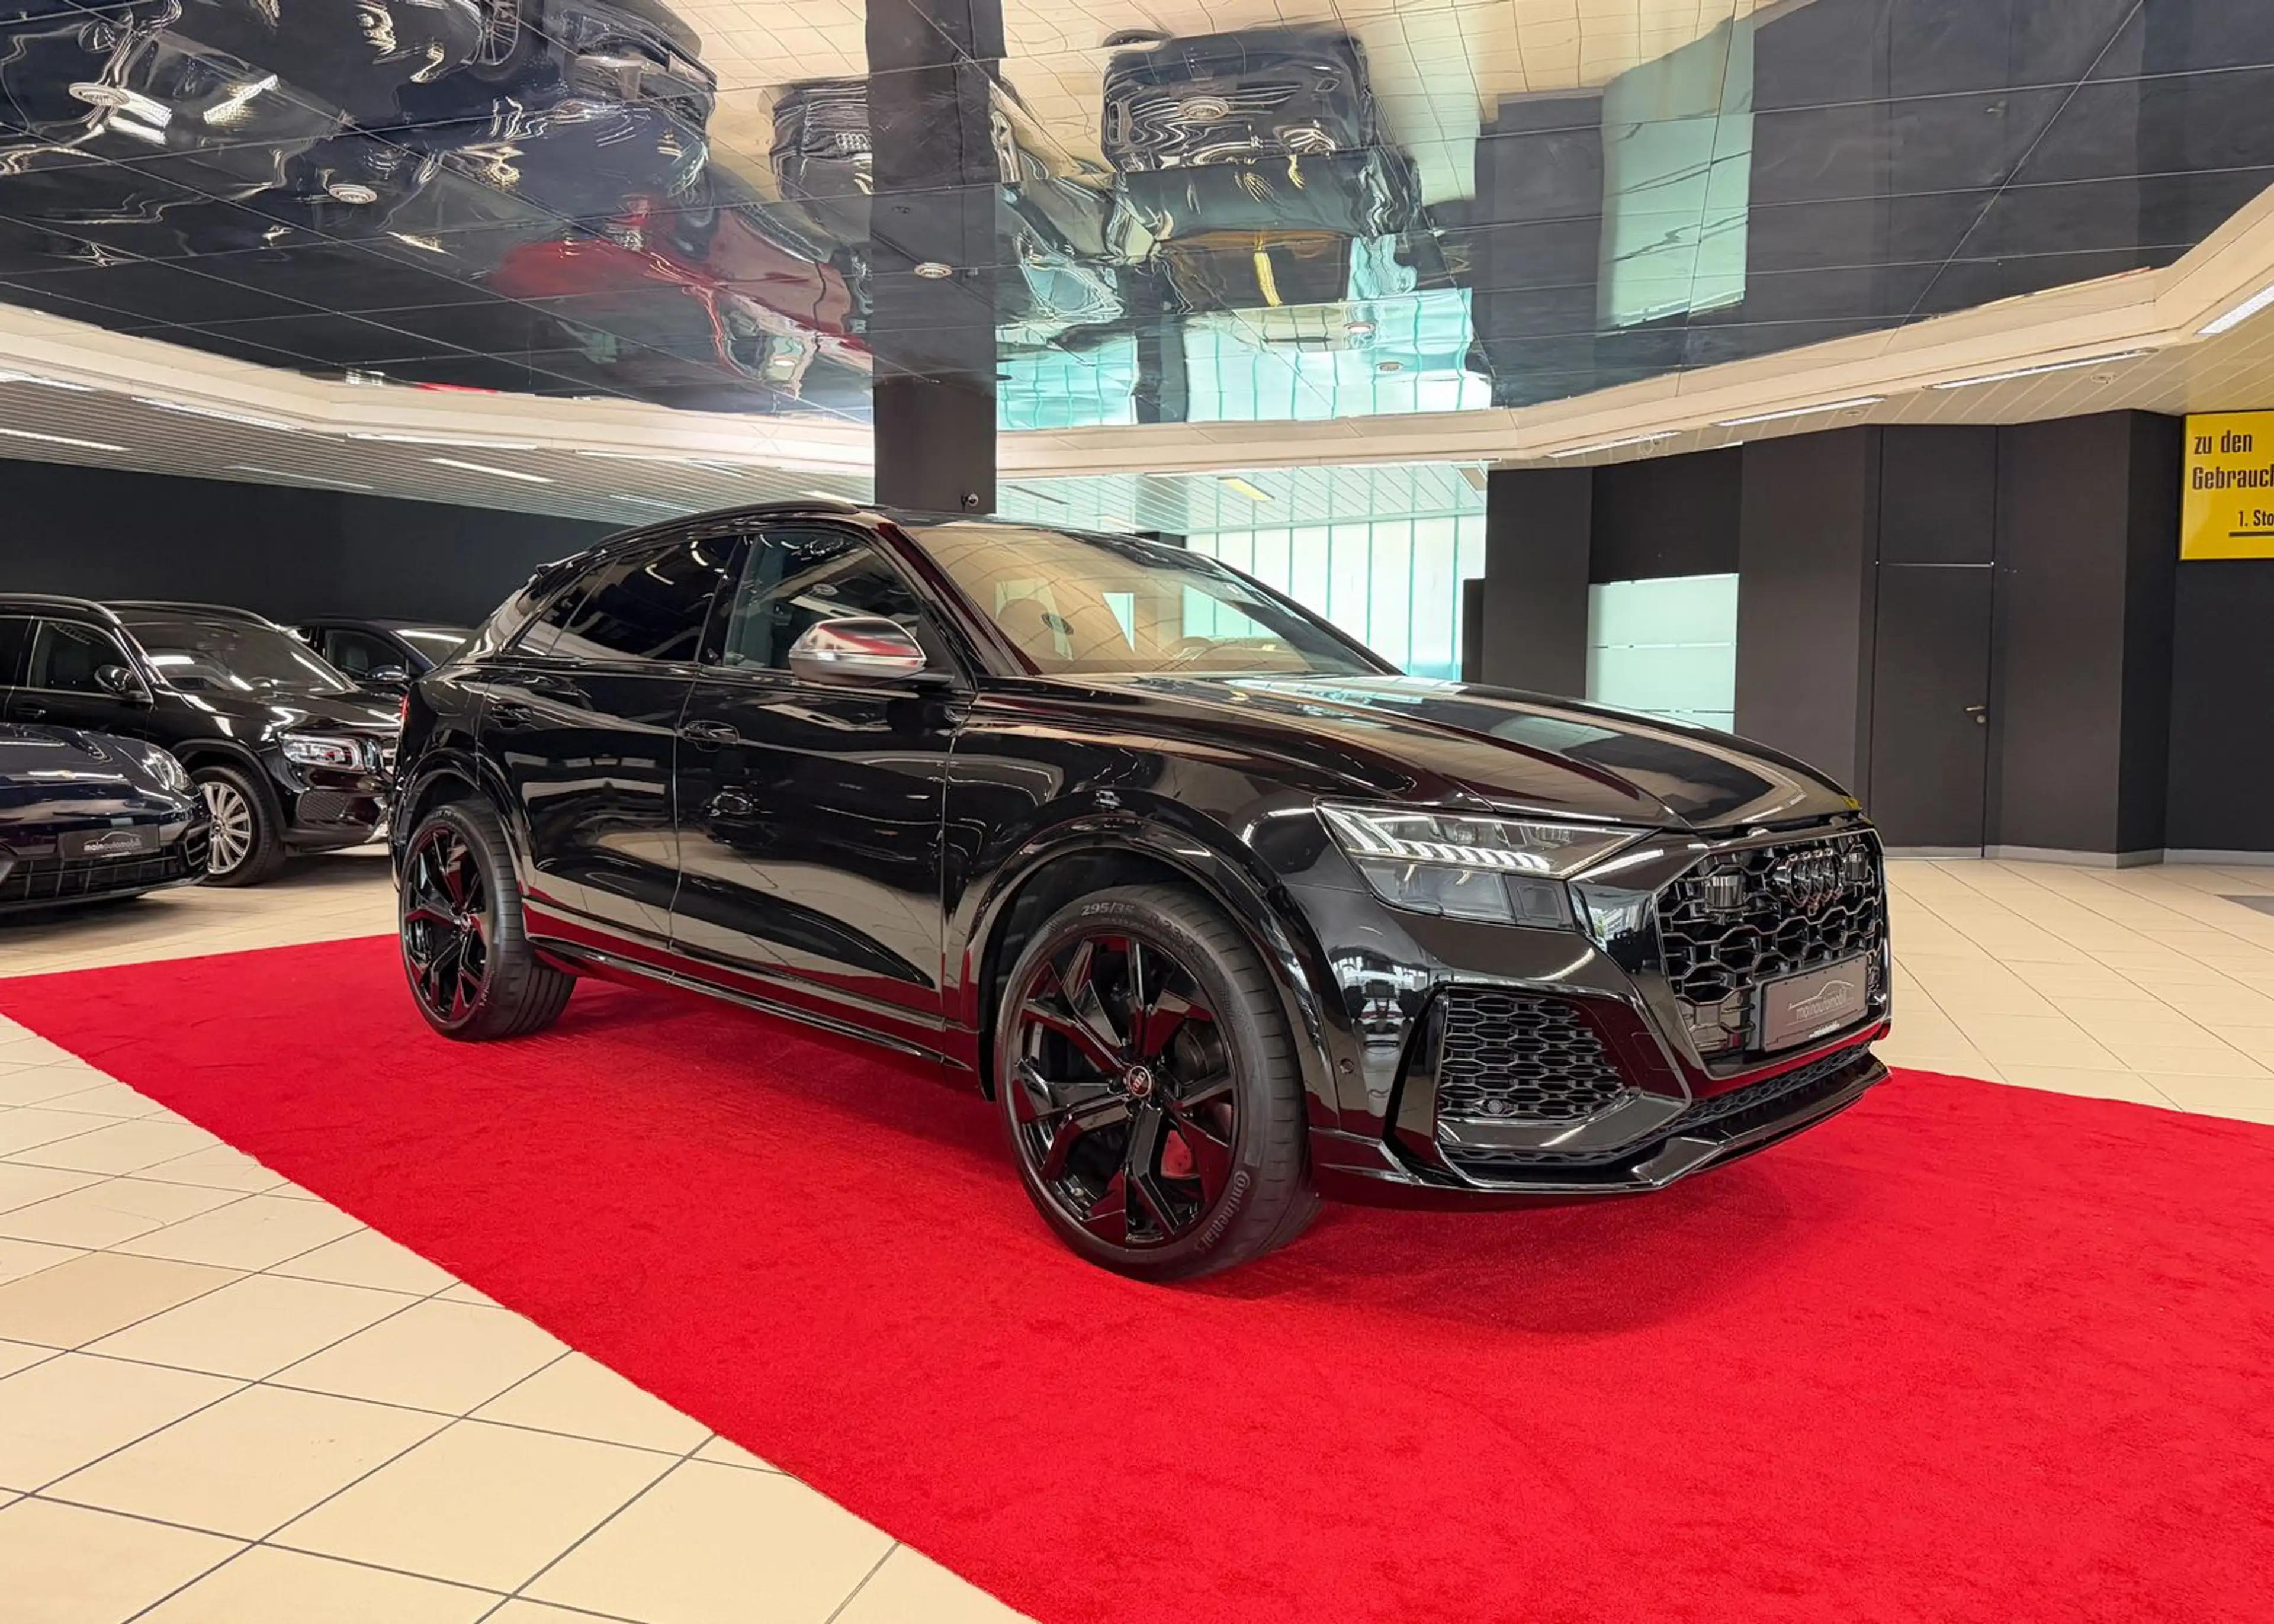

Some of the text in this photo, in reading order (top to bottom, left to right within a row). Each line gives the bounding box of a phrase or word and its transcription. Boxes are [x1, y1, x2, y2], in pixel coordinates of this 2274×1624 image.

[2193, 430, 2252, 454] zu den
[2238, 510, 2249, 526] 1.
